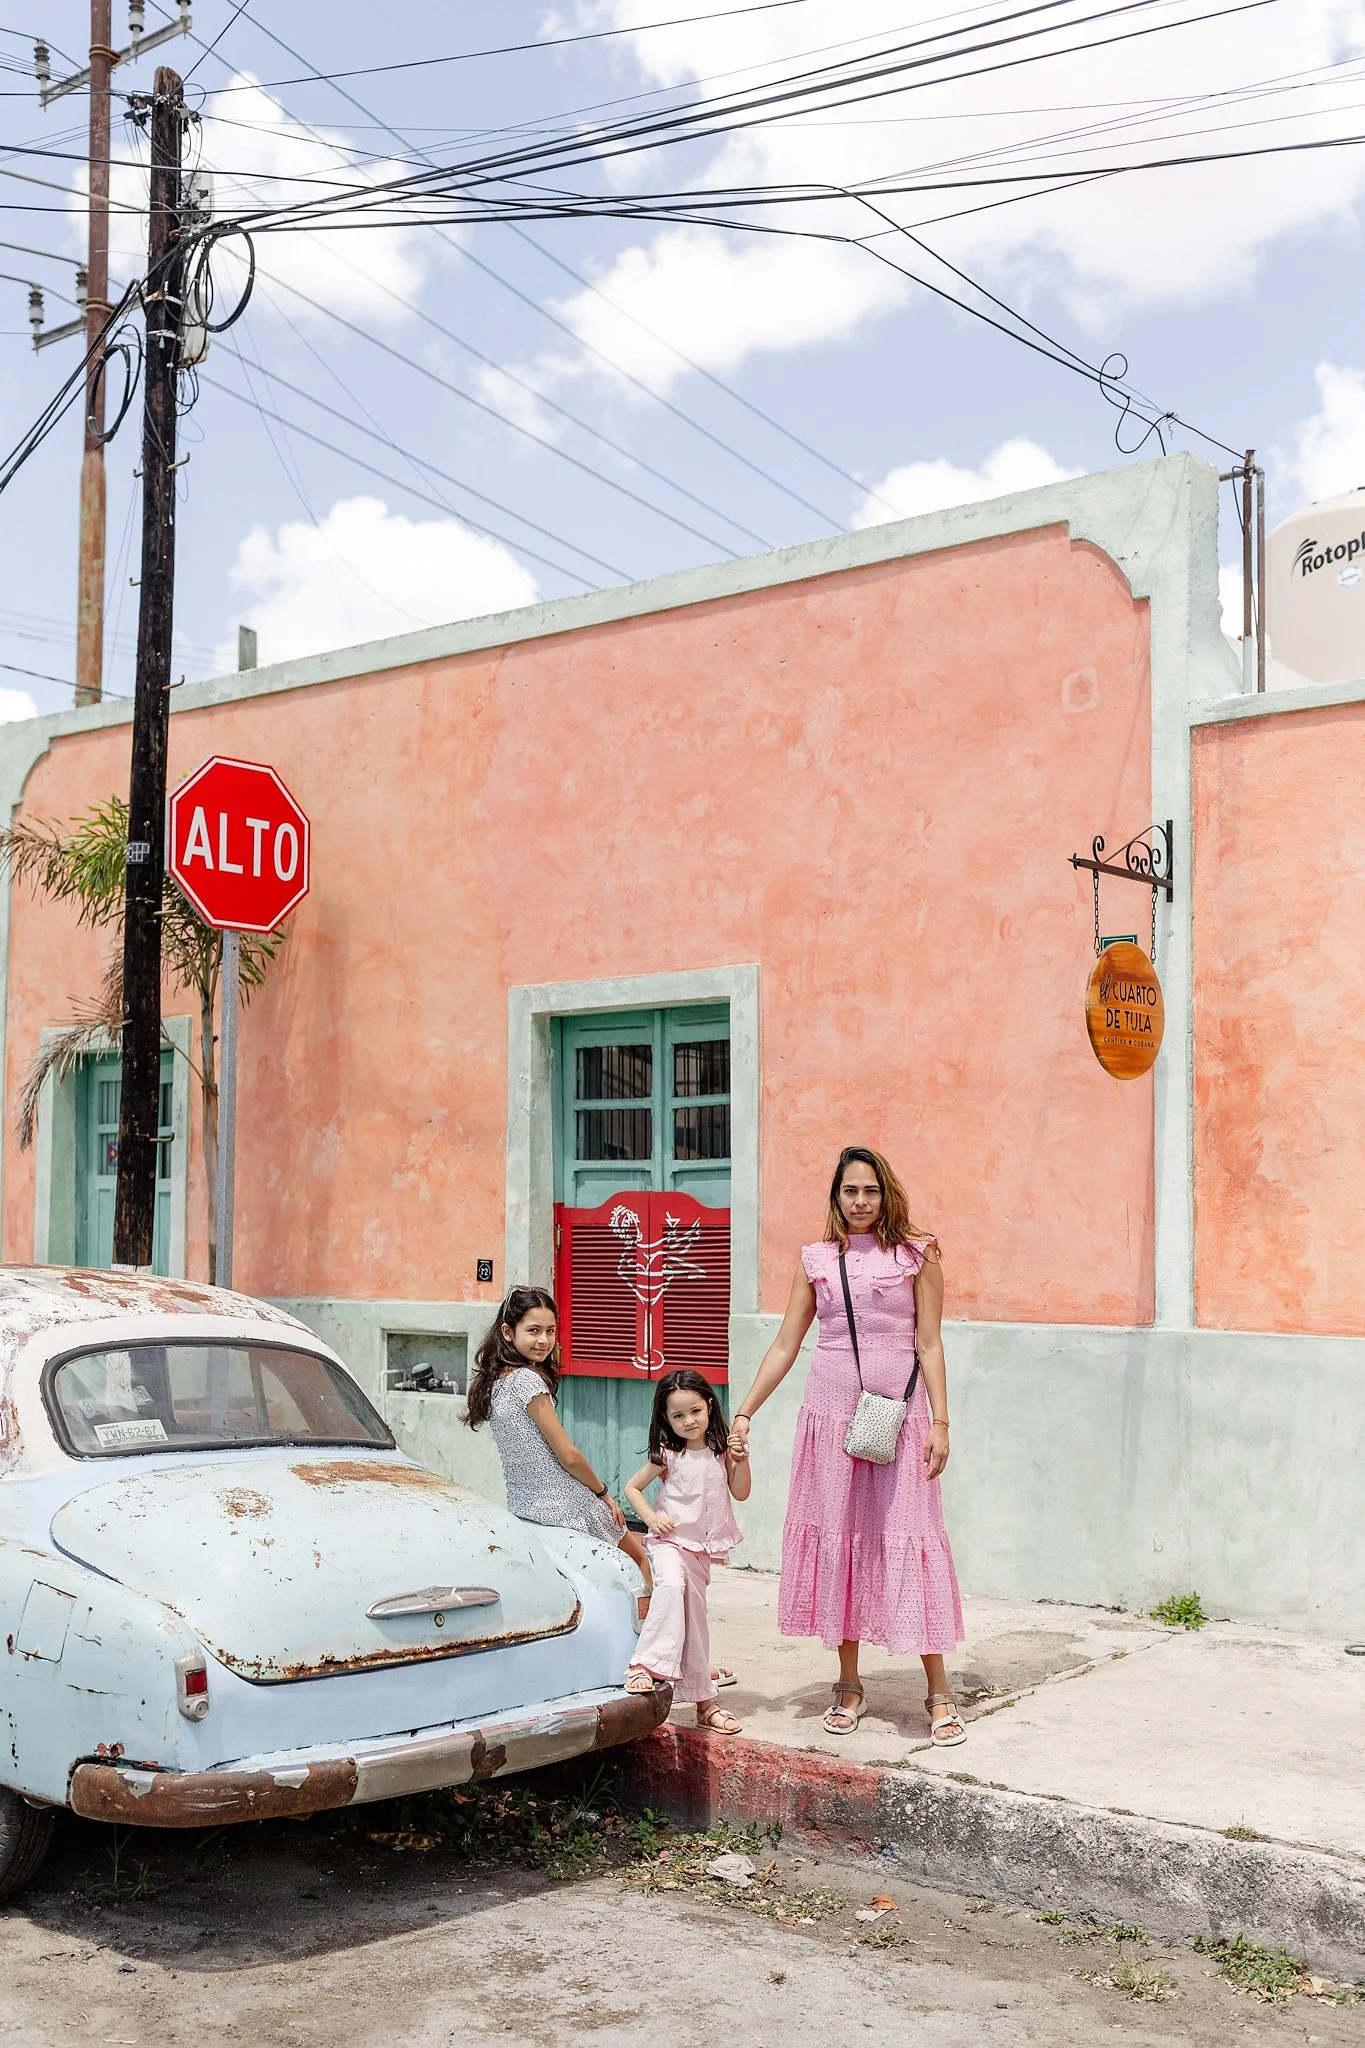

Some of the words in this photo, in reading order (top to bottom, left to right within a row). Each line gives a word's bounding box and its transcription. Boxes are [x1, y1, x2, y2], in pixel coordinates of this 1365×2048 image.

[182, 805, 299, 882] ALTO
[1100, 973, 1111, 1002] el
[1112, 982, 1157, 1006] CUARTO
[1106, 1008, 1121, 1029] DE
[1124, 1010, 1153, 1033] TULA
[1103, 1036, 1127, 1046] CANTINA
[1133, 1039, 1155, 1048] CUBANA
[102, 1425, 157, 1440] YWN-62-67
